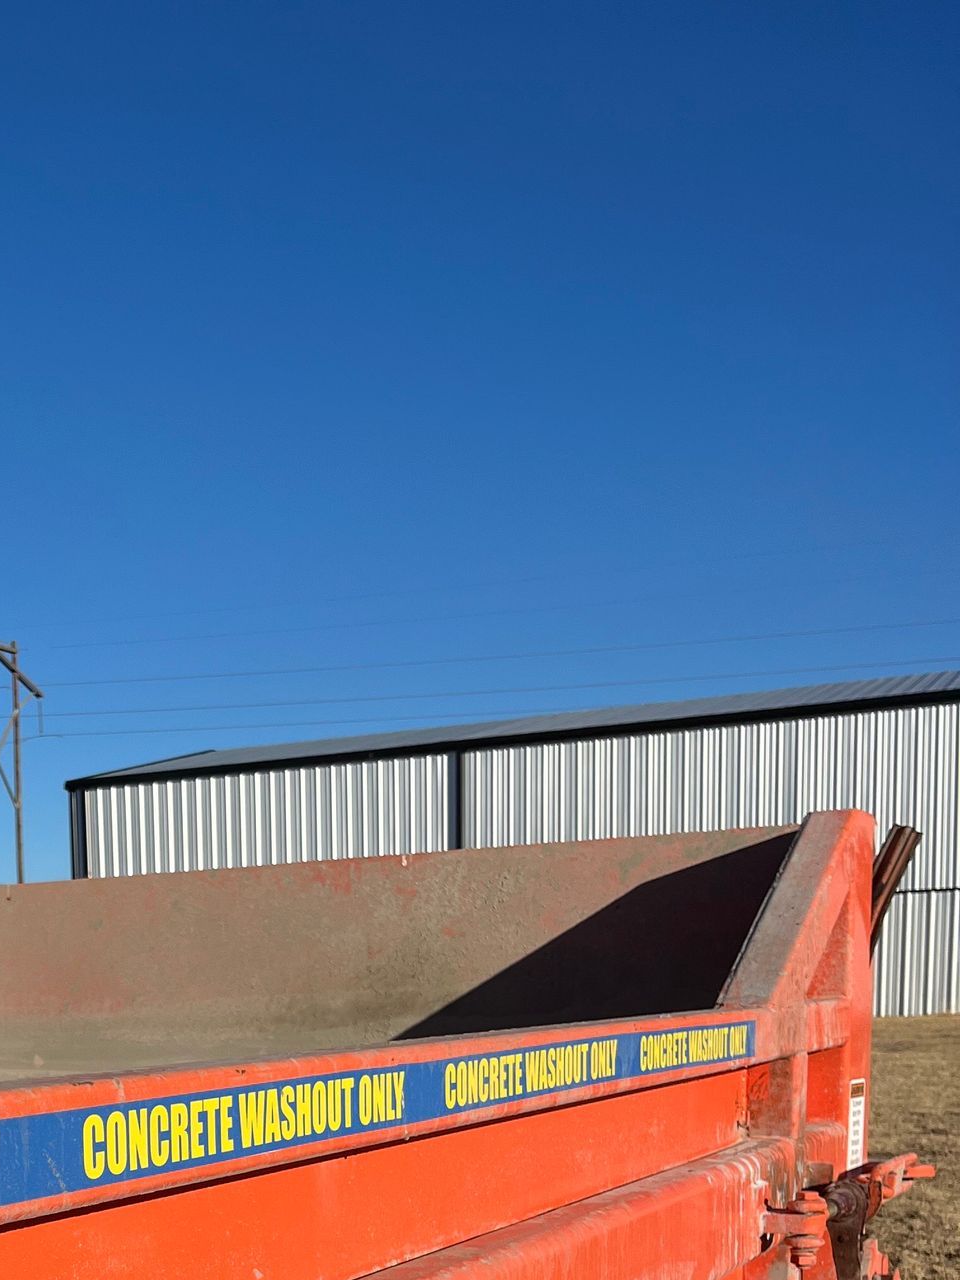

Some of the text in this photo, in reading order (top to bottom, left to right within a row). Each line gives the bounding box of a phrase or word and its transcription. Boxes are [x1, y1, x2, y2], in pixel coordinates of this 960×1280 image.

[444, 1039, 618, 1109] CONCRETE WASHOUT ONLY
[640, 1025, 748, 1072] CONCRETE WASHOUT ONLY
[82, 1071, 406, 1180] CONCRETE WASHOUT ONLY
